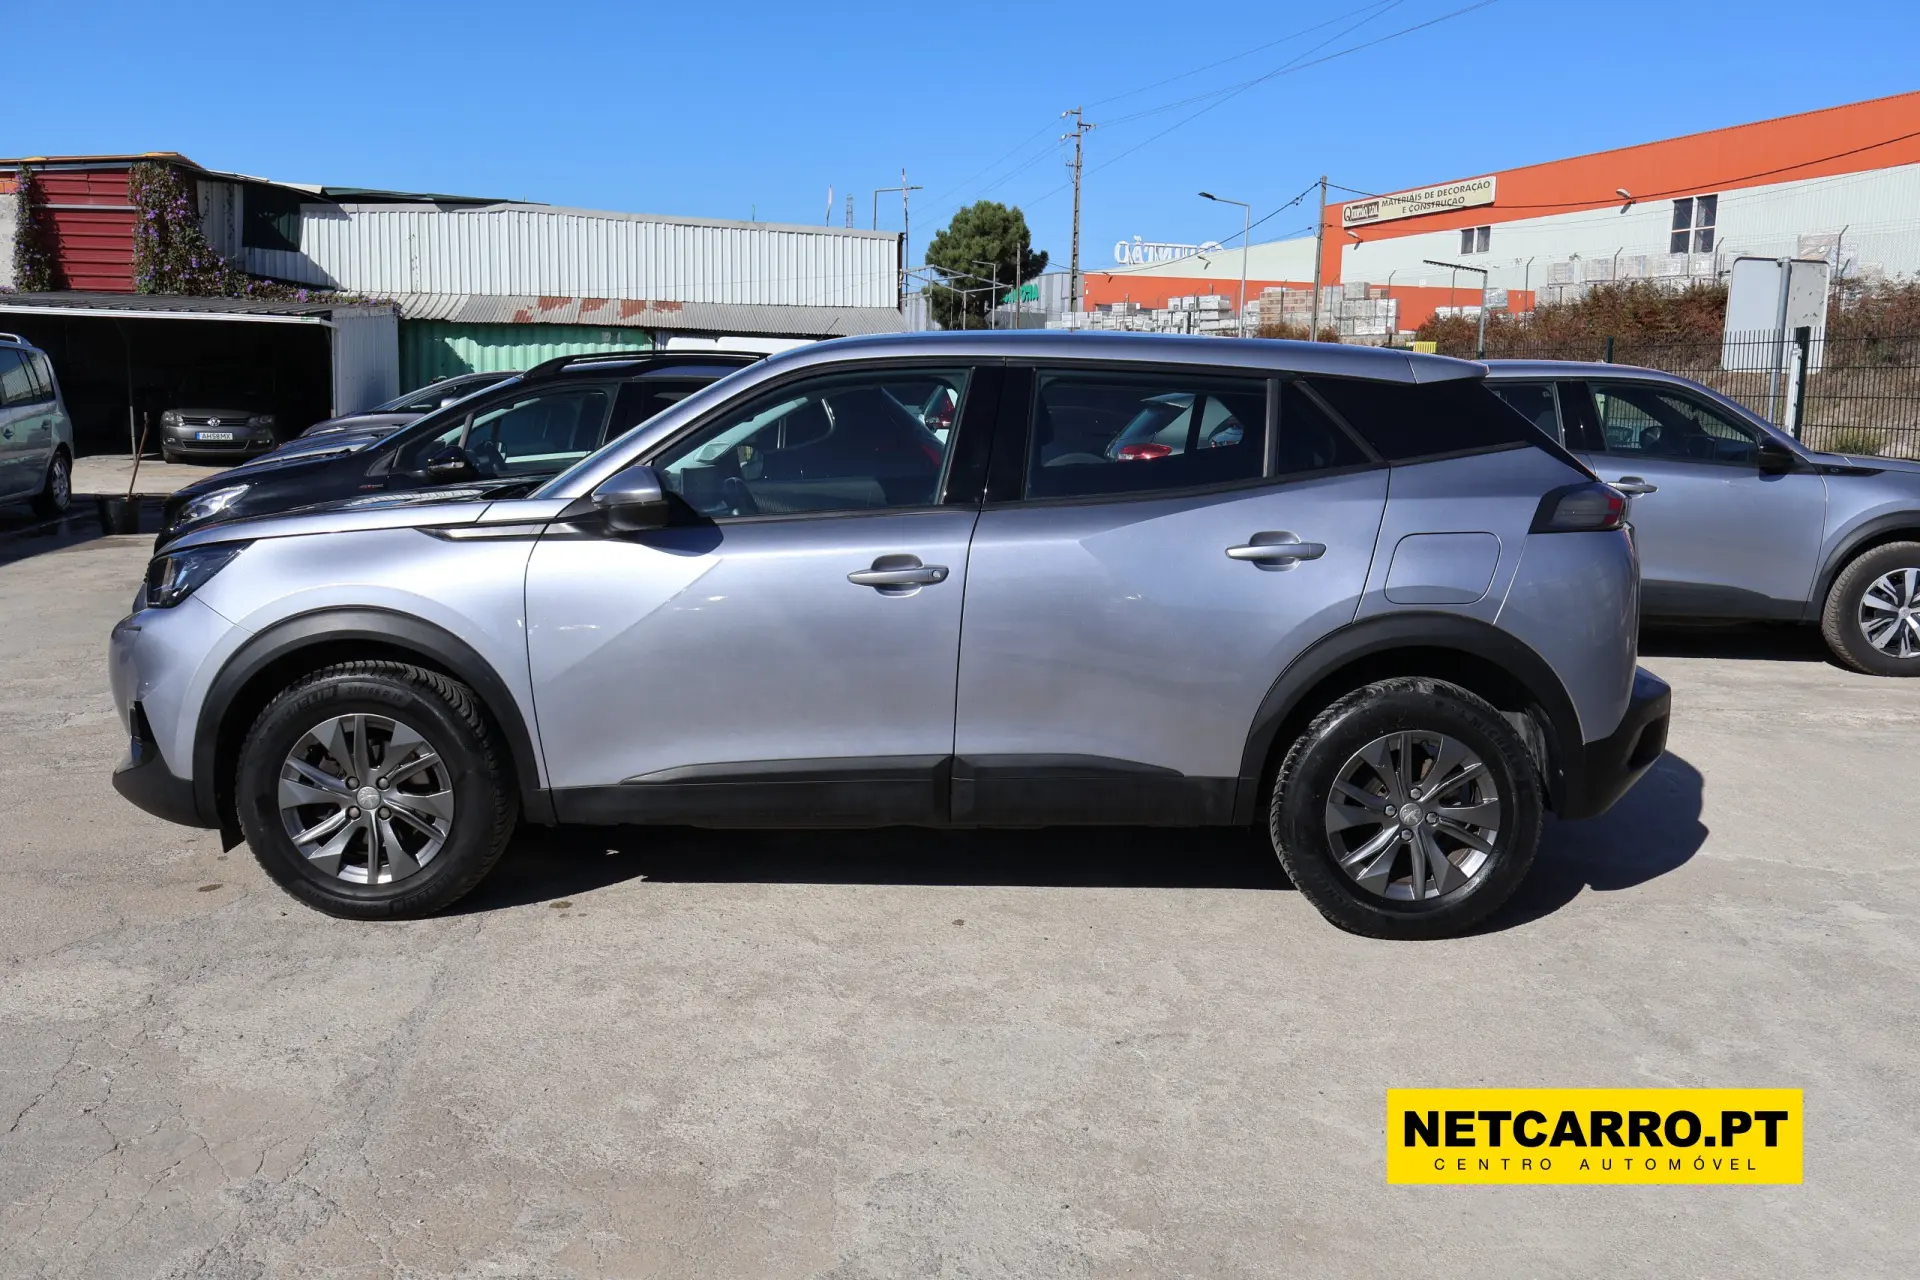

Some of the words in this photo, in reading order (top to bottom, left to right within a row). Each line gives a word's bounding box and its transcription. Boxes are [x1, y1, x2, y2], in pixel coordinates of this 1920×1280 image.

[1381, 191, 1422, 207] MATERIAIS
[1424, 189, 1435, 199] DE
[1436, 180, 1491, 198] DECORAÇÃO
[1402, 206, 1407, 214] E
